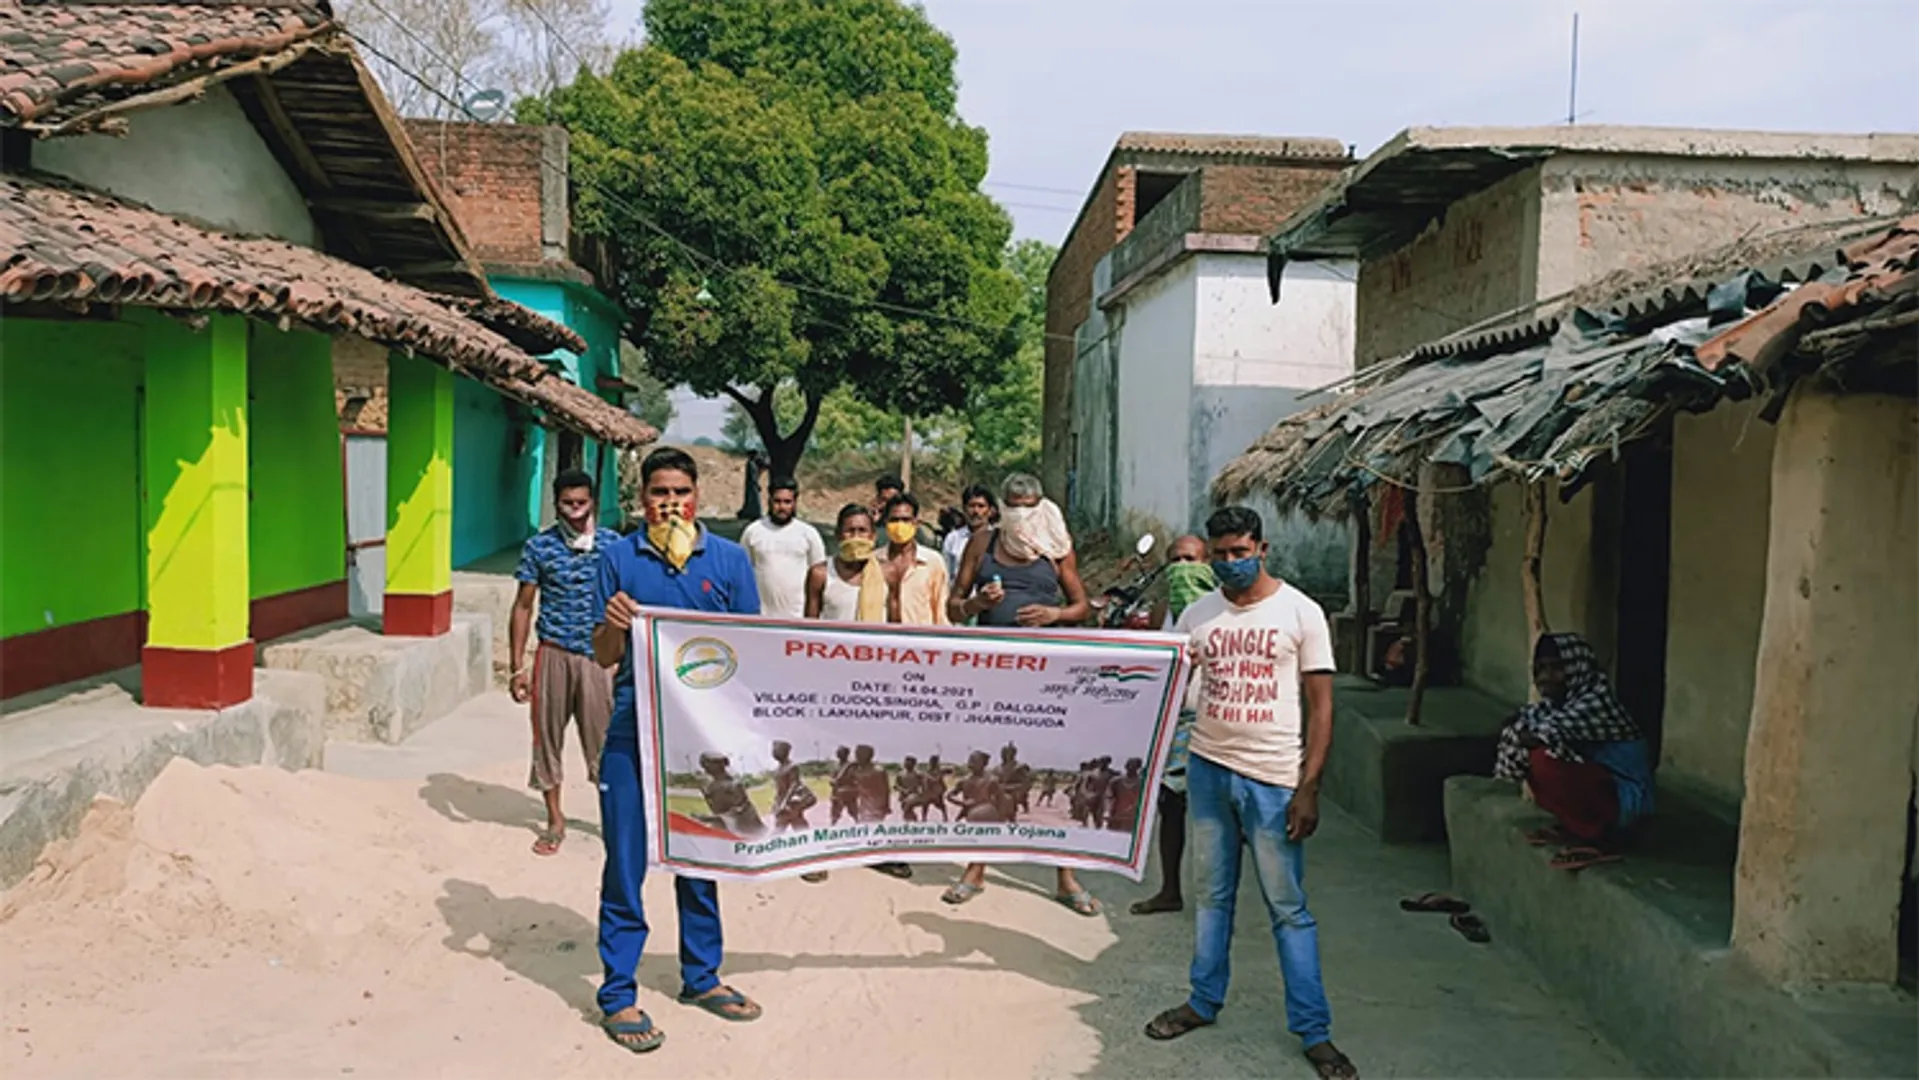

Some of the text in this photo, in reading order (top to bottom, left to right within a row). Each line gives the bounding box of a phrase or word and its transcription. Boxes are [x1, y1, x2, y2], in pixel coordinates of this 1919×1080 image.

[784, 639, 942, 666] PRABHAT
[950, 651, 1048, 672] PHERI
[1204, 628, 1279, 659] SINGLE
[902, 671, 926, 682] ON
[902, 684, 974, 697] 14.04.2021
[753, 691, 818, 705] VILLAGE
[993, 701, 1068, 716] DALGAON
[752, 706, 806, 718] BLOCK
[918, 711, 952, 723] DIST
[963, 714, 1065, 728] JHARSUGUDA
[733, 833, 809, 855] Pradhan
[813, 825, 869, 842] Mantri
[873, 824, 949, 836] Aadarsh
[953, 824, 1002, 836] Gram
[1006, 823, 1067, 839] Yojana
